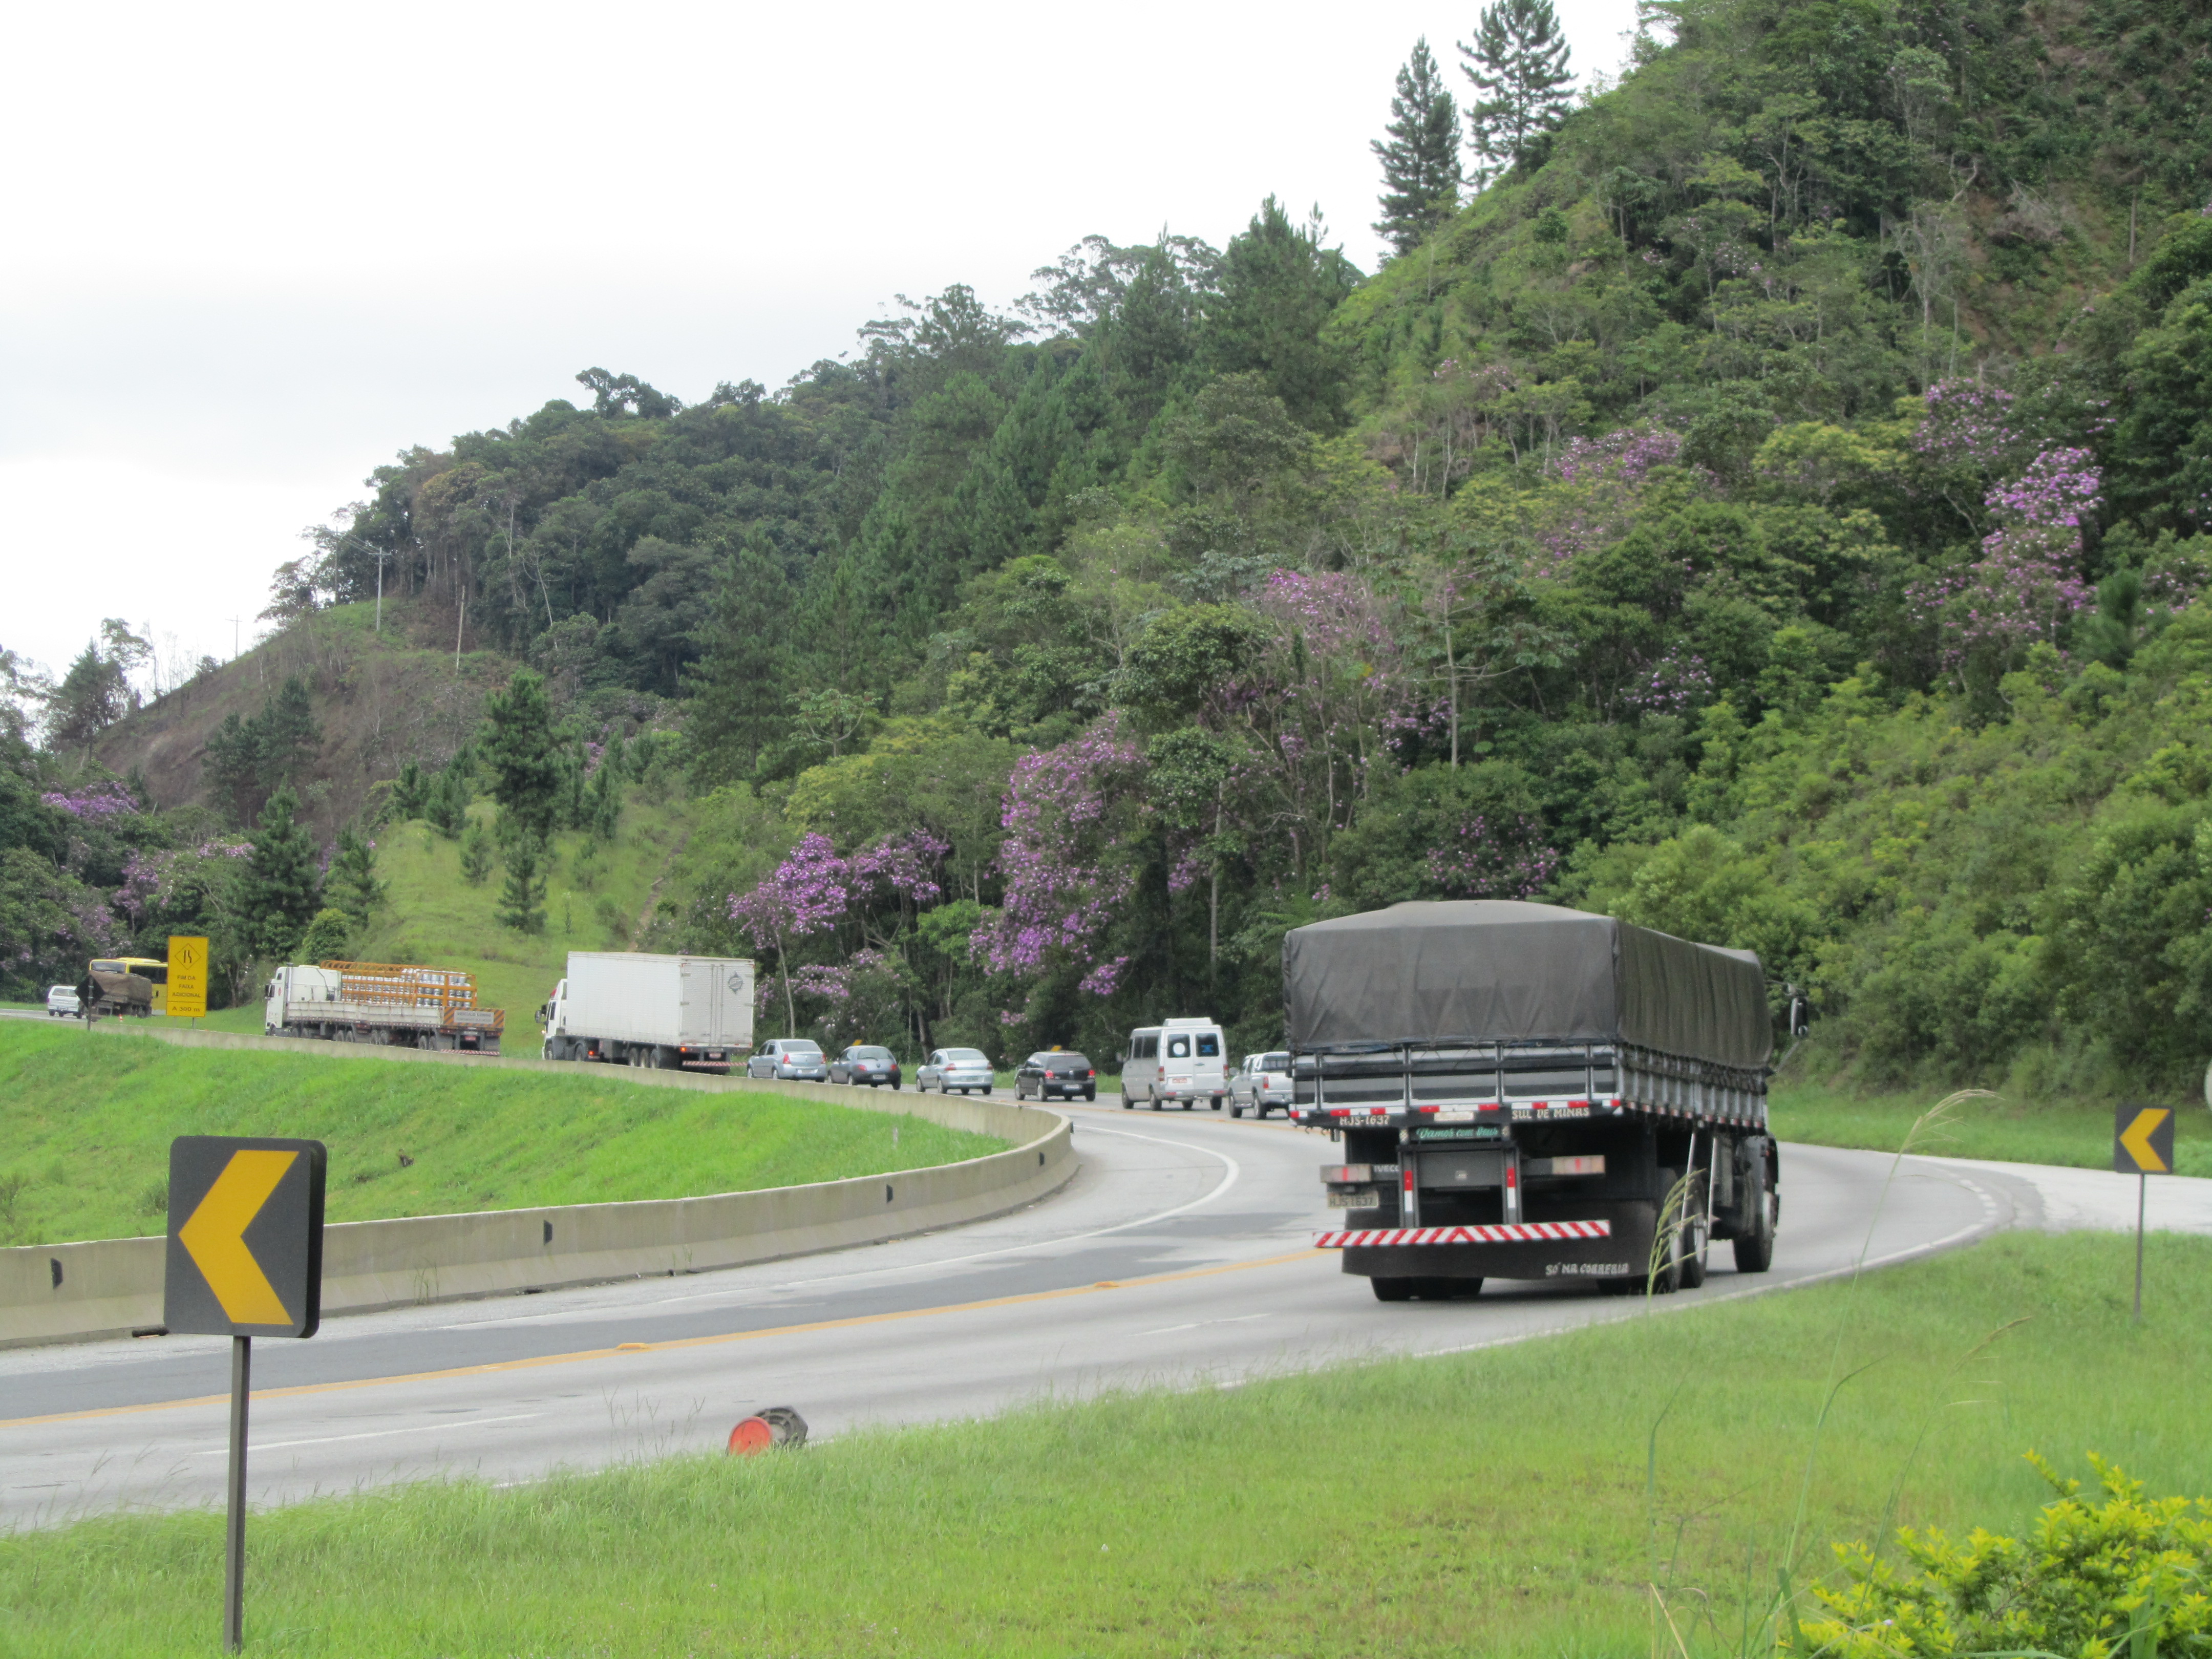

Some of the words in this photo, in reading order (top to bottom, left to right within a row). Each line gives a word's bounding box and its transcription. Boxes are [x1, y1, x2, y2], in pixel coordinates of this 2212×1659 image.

[1512, 1110, 1532, 1119] SUL
[1537, 1109, 1549, 1118] DE
[1554, 1107, 1590, 1117] MINAS
[1339, 1116, 1390, 1125] HJS-1637
